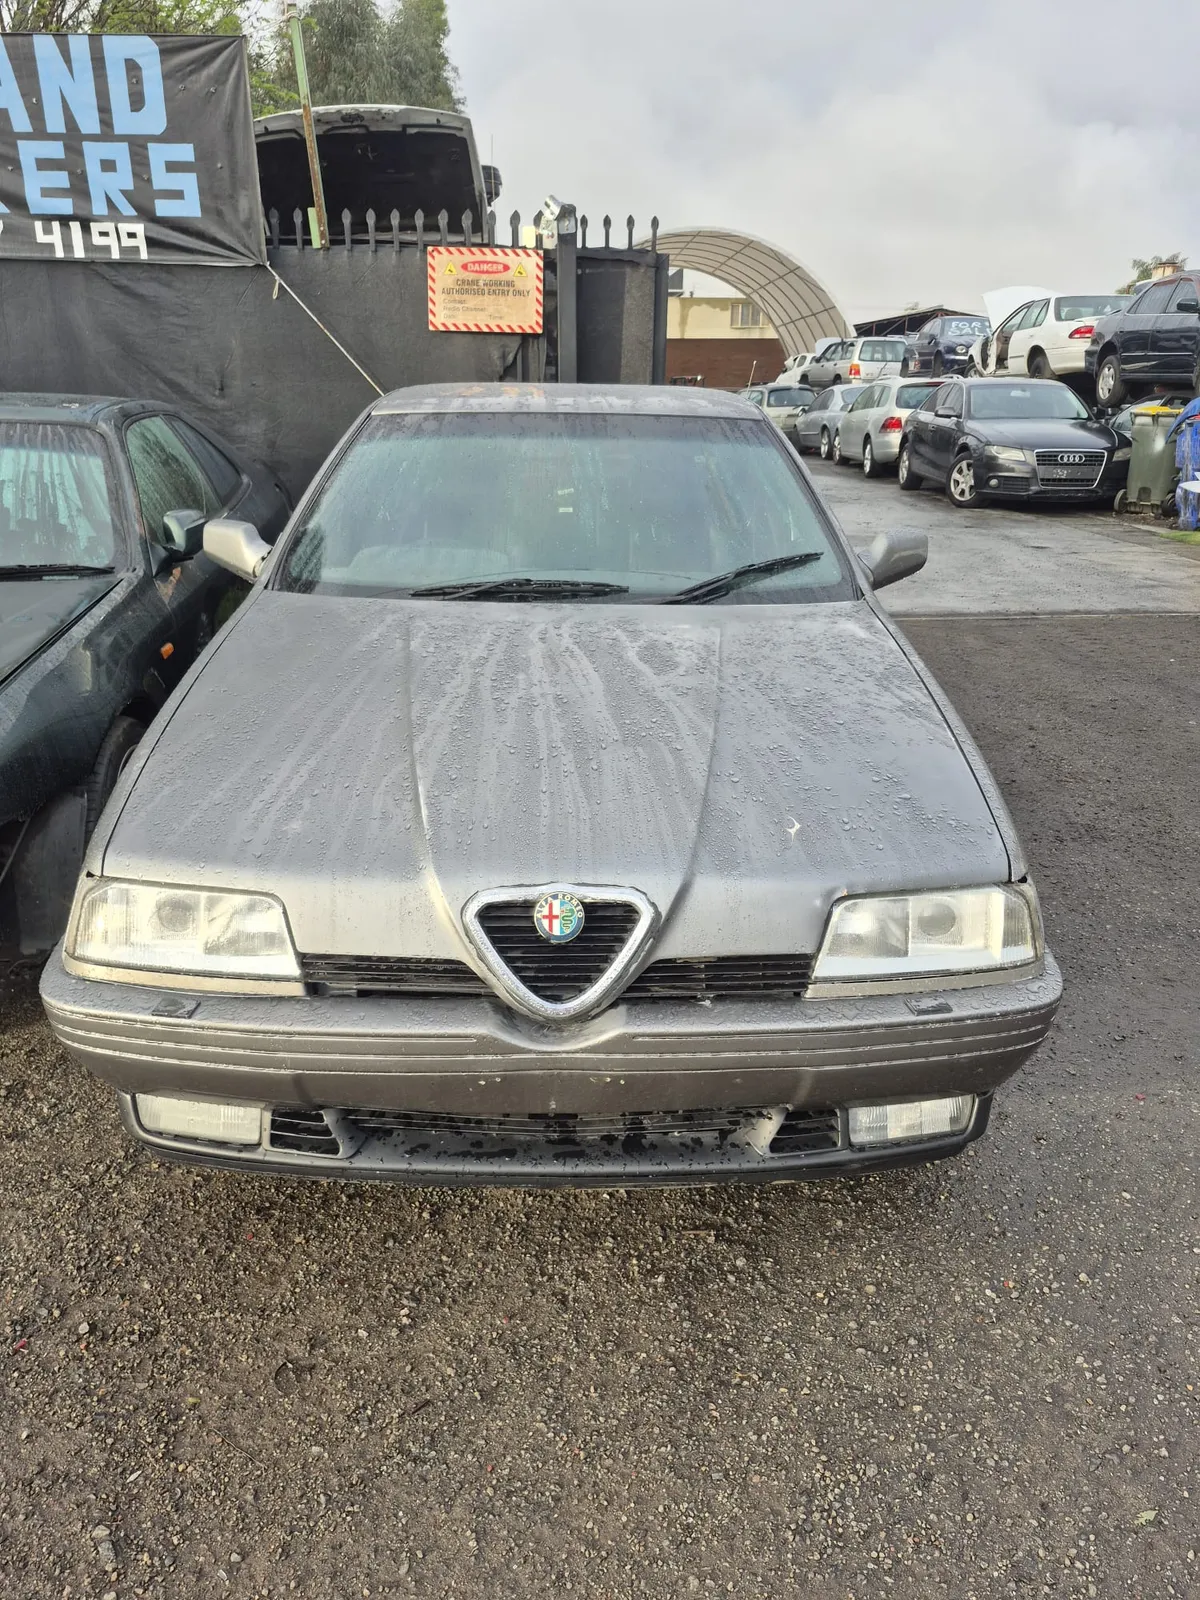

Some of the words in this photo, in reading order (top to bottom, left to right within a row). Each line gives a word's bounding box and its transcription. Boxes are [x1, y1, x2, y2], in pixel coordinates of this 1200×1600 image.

[0, 140, 202, 217] ERS
[34, 220, 148, 259] 4199
[467, 263, 504, 272] DANGER
[456, 279, 480, 287] CRANE
[482, 279, 515, 287] WORKING
[442, 288, 486, 296] AUTHORISED
[488, 288, 510, 297] ENTRY
[512, 289, 531, 297] ONLY
